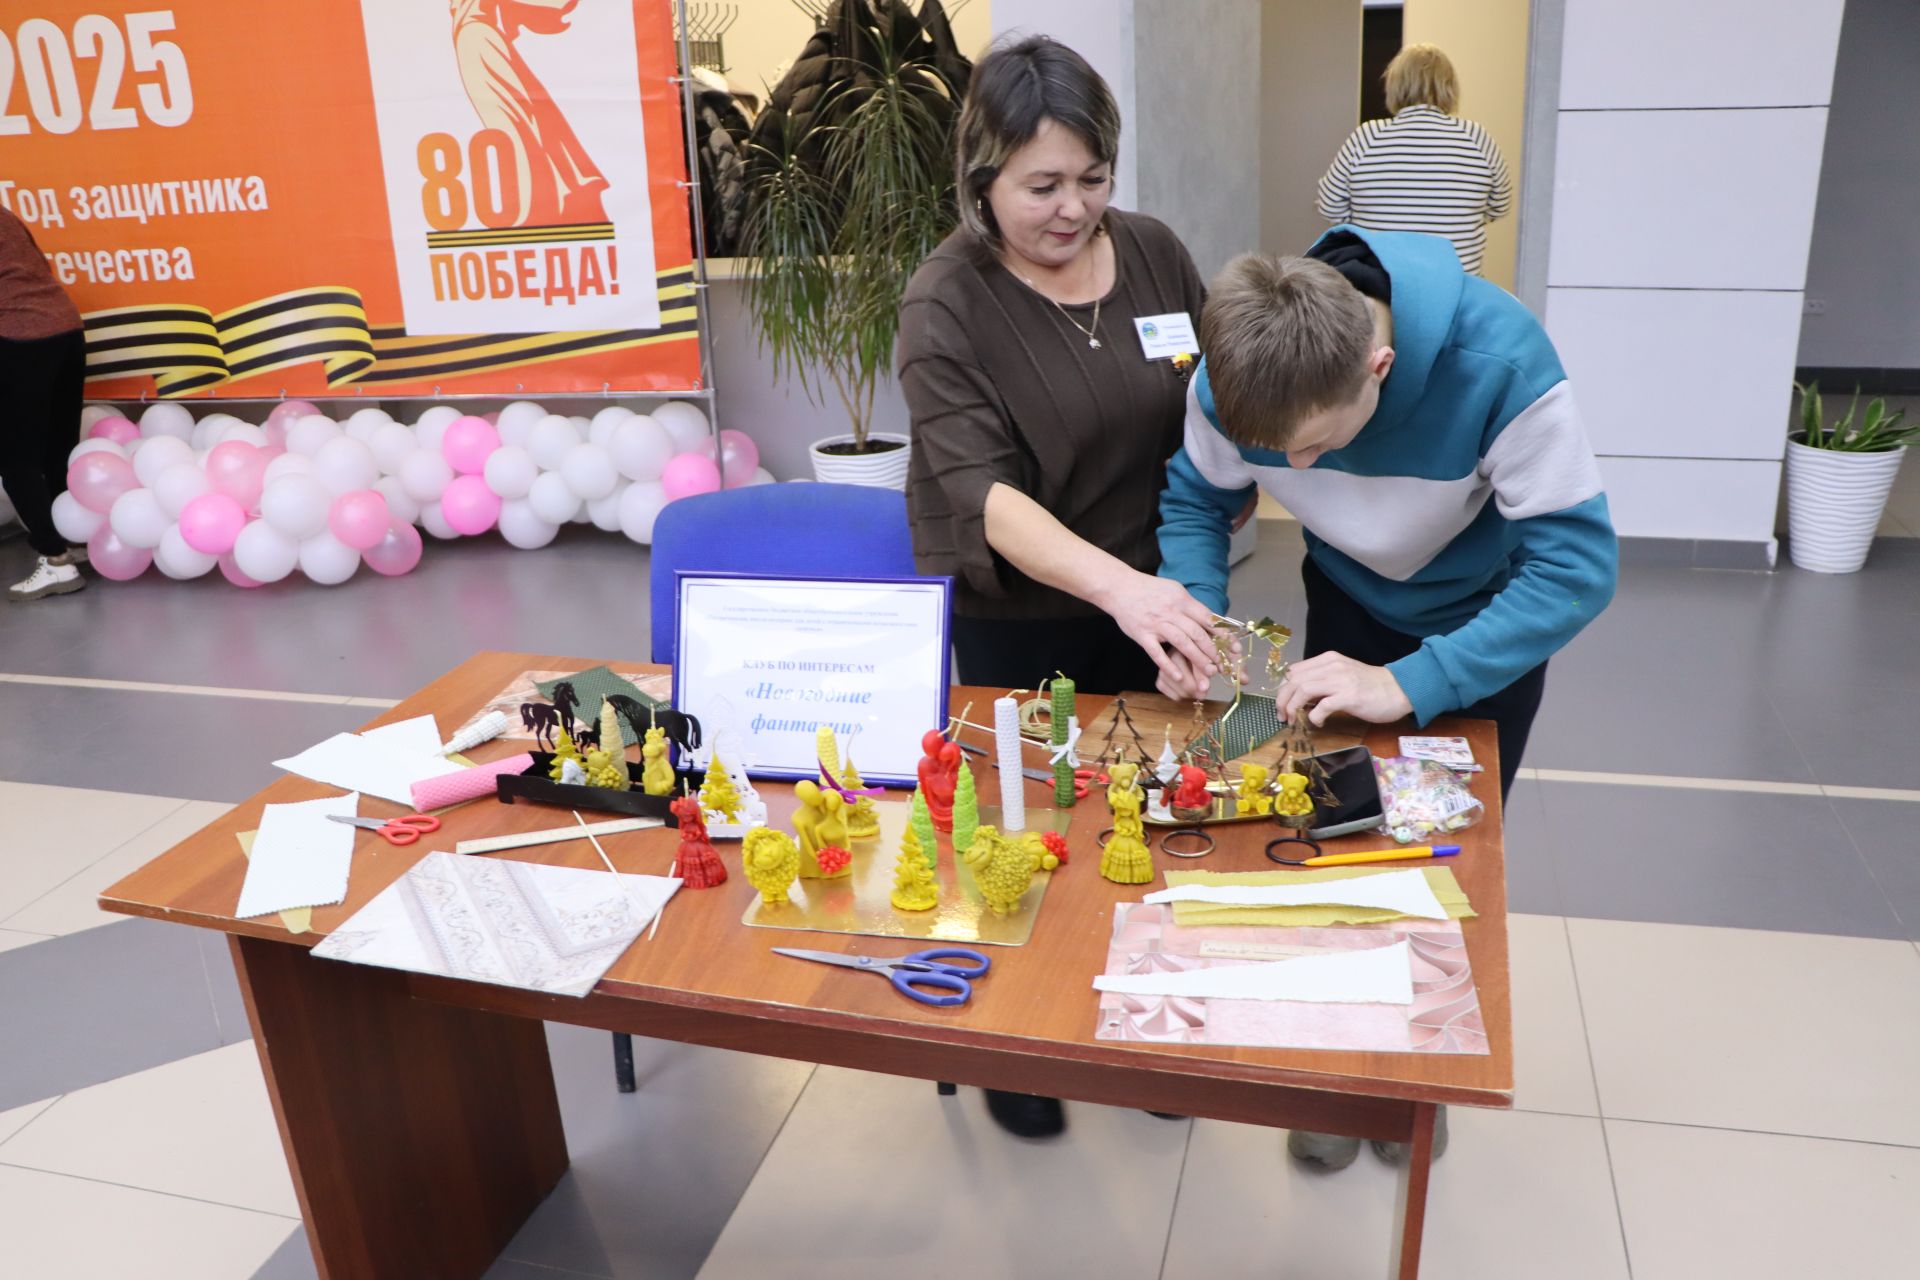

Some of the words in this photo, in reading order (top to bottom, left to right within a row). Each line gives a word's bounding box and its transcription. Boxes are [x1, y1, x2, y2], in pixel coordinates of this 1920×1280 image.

[69, 175, 269, 225] защитника
[416, 127, 522, 231] 80
[44, 246, 195, 285] ечества
[429, 245, 620, 306] ПОБЕДА!
[778, 660, 796, 671] ПО
[798, 661, 876, 674] ИНТЕРЕСАМ
[750, 713, 864, 735] фантаии»
